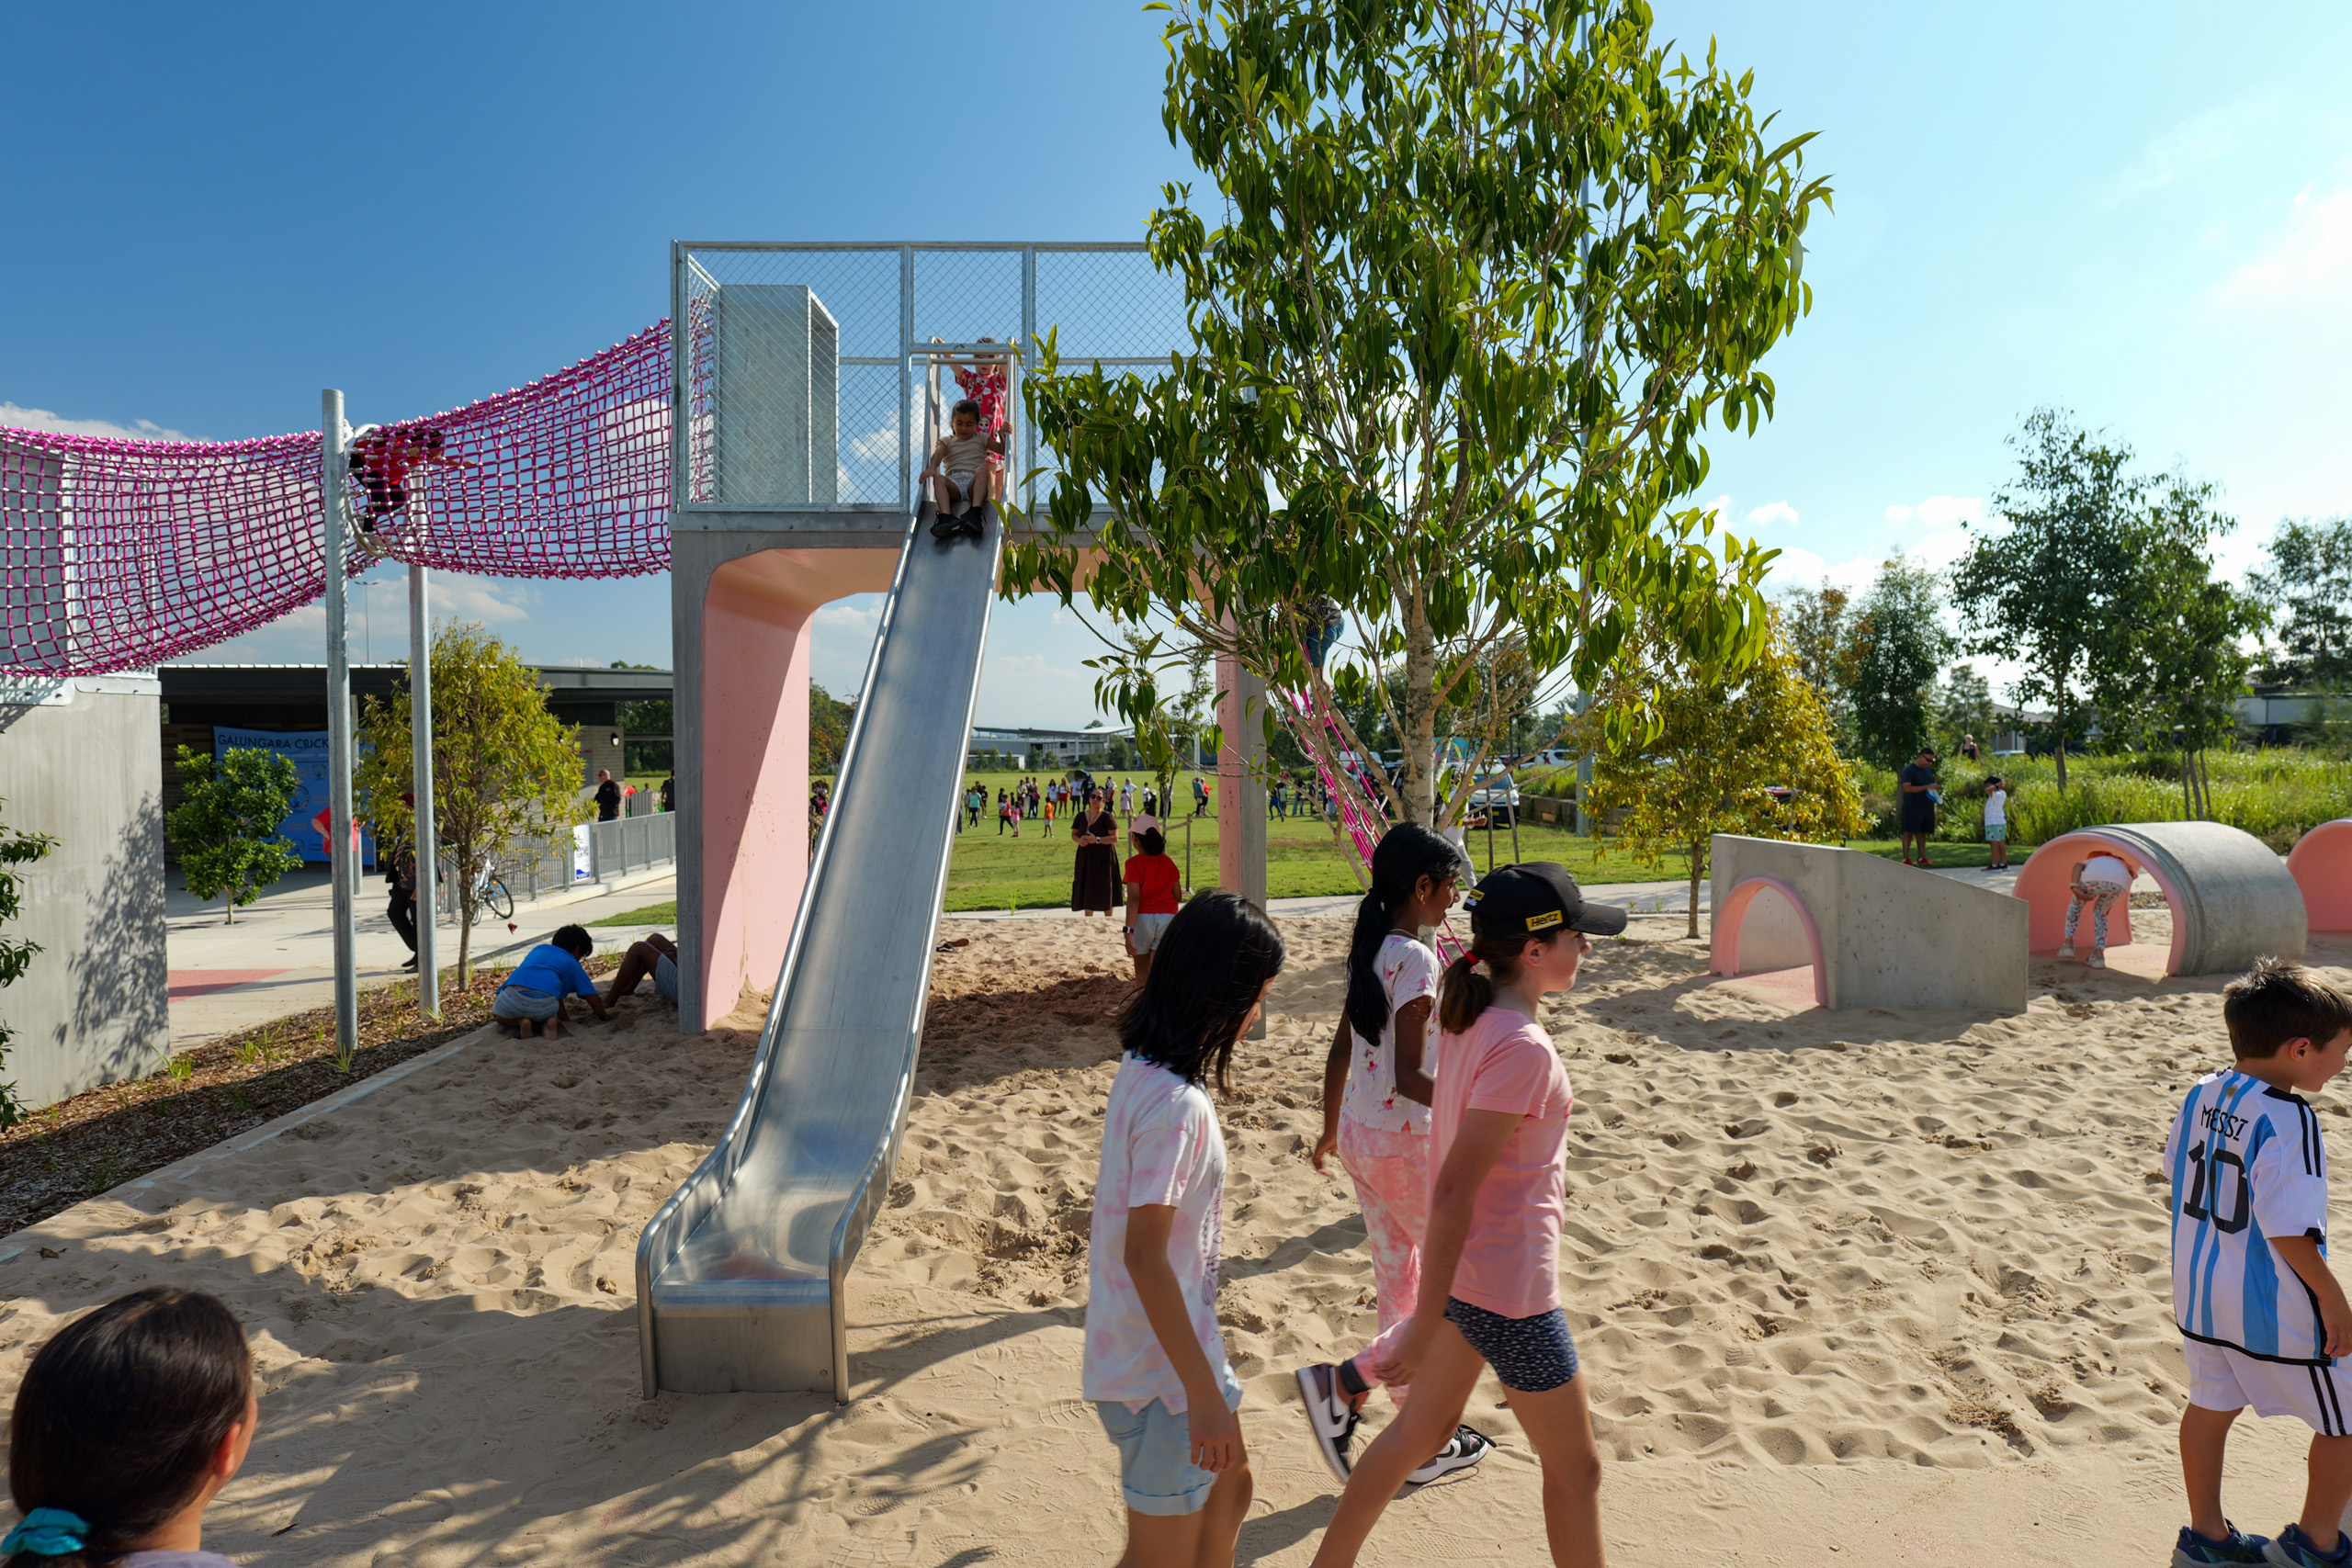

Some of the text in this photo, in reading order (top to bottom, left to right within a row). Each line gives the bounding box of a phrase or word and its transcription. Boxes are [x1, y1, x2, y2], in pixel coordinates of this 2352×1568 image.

[218, 734, 329, 750] GALUNGARA CRICK
[1531, 912, 1559, 928] Hertz
[2200, 1104, 2249, 1142] MESSI
[2183, 1139, 2250, 1235] 10
